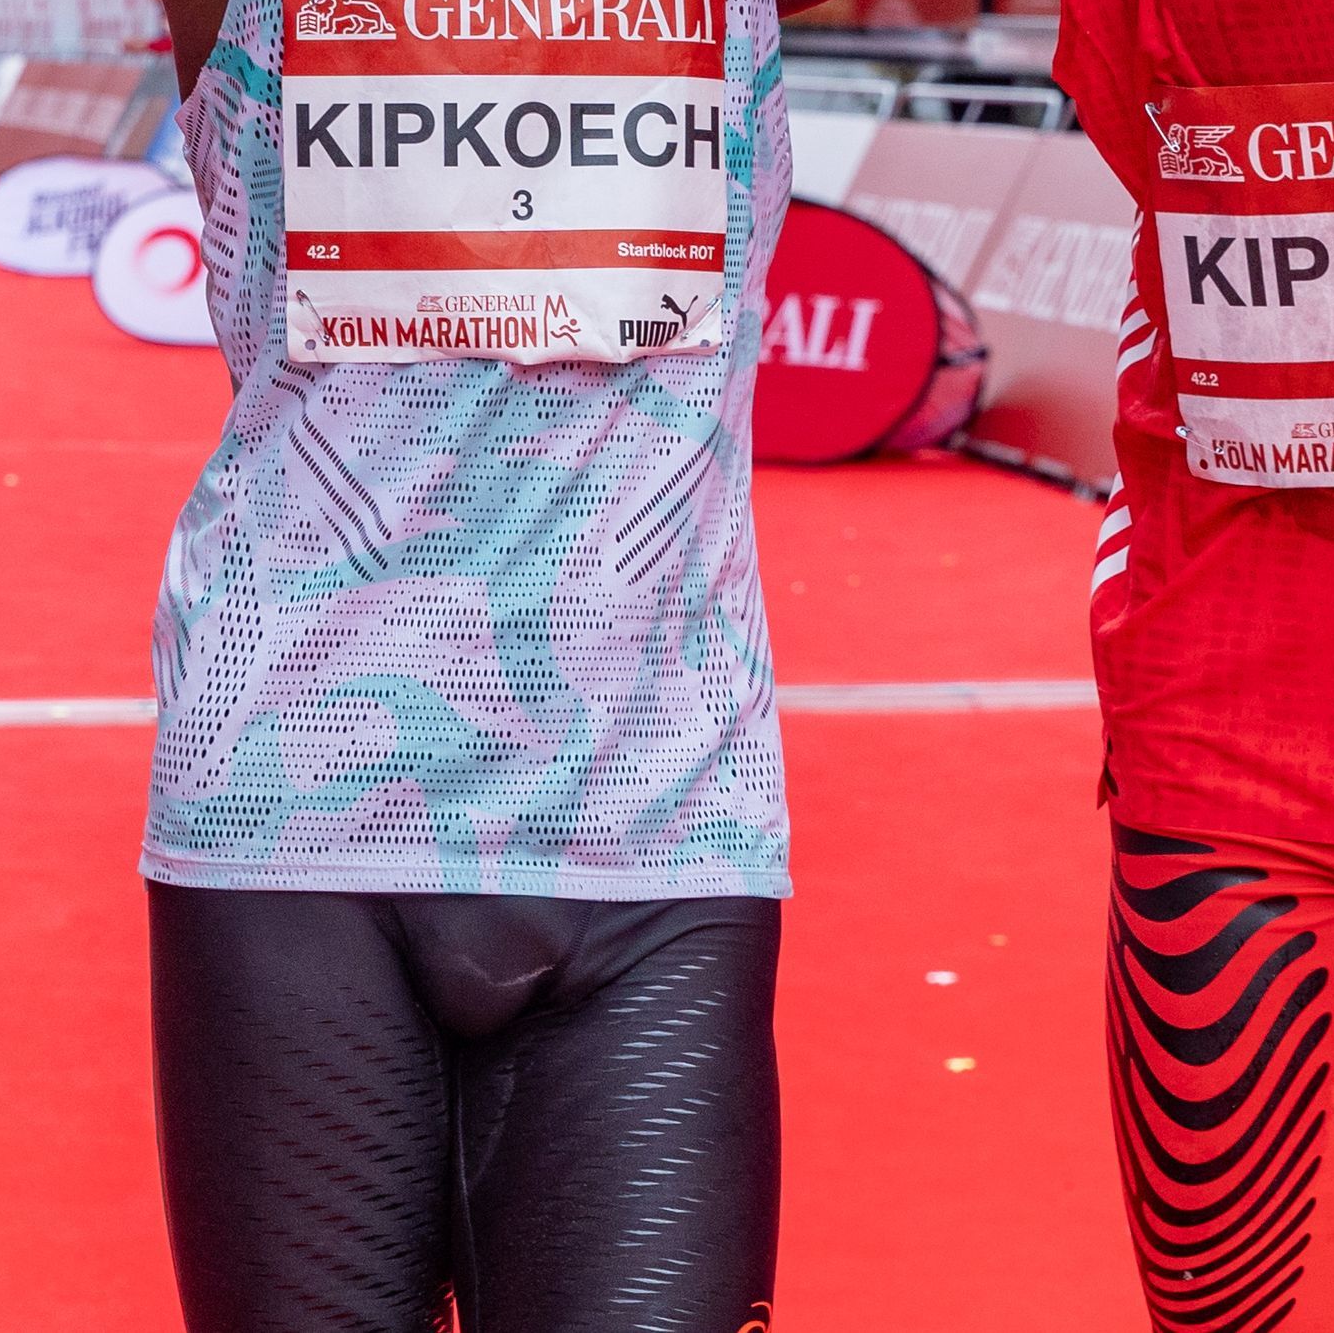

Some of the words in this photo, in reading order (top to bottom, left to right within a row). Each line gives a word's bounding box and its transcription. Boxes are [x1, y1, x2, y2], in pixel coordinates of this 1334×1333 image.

[295, 101, 721, 171] KIPKOECH
[511, 189, 535, 221] 3
[306, 244, 341, 261] 42.2
[617, 242, 687, 259] Startblock
[689, 244, 716, 261] ROT
[445, 294, 536, 313] GENERALI
[323, 316, 389, 347] KÖLN
[395, 316, 538, 349] MARATHON
[758, 291, 884, 372] ALI
[1190, 371, 1219, 387] 42.2
[1212, 439, 1268, 474] KÖLN
